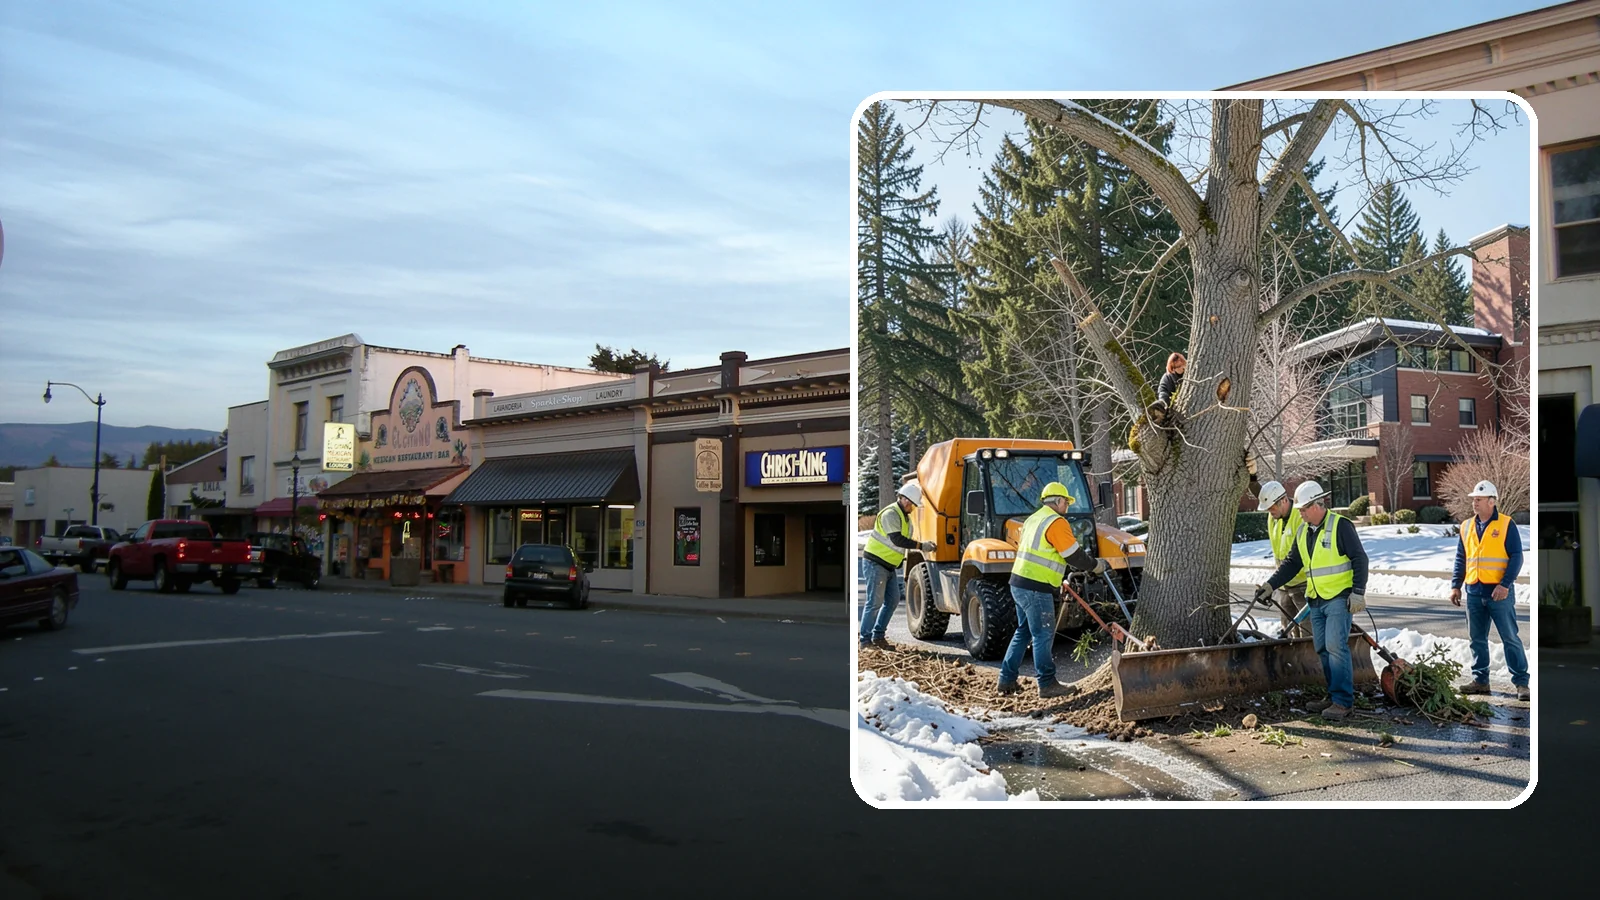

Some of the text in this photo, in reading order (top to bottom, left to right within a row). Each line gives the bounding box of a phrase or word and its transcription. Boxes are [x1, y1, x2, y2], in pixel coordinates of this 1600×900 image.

[561, 394, 582, 404] Shop
[595, 389, 624, 400] LAUNDRY
[493, 402, 523, 413] LAVANDERIA
[397, 451, 433, 462] RESTAURANT
[437, 450, 450, 459] BAR
[760, 450, 827, 478] CHRIST KING
